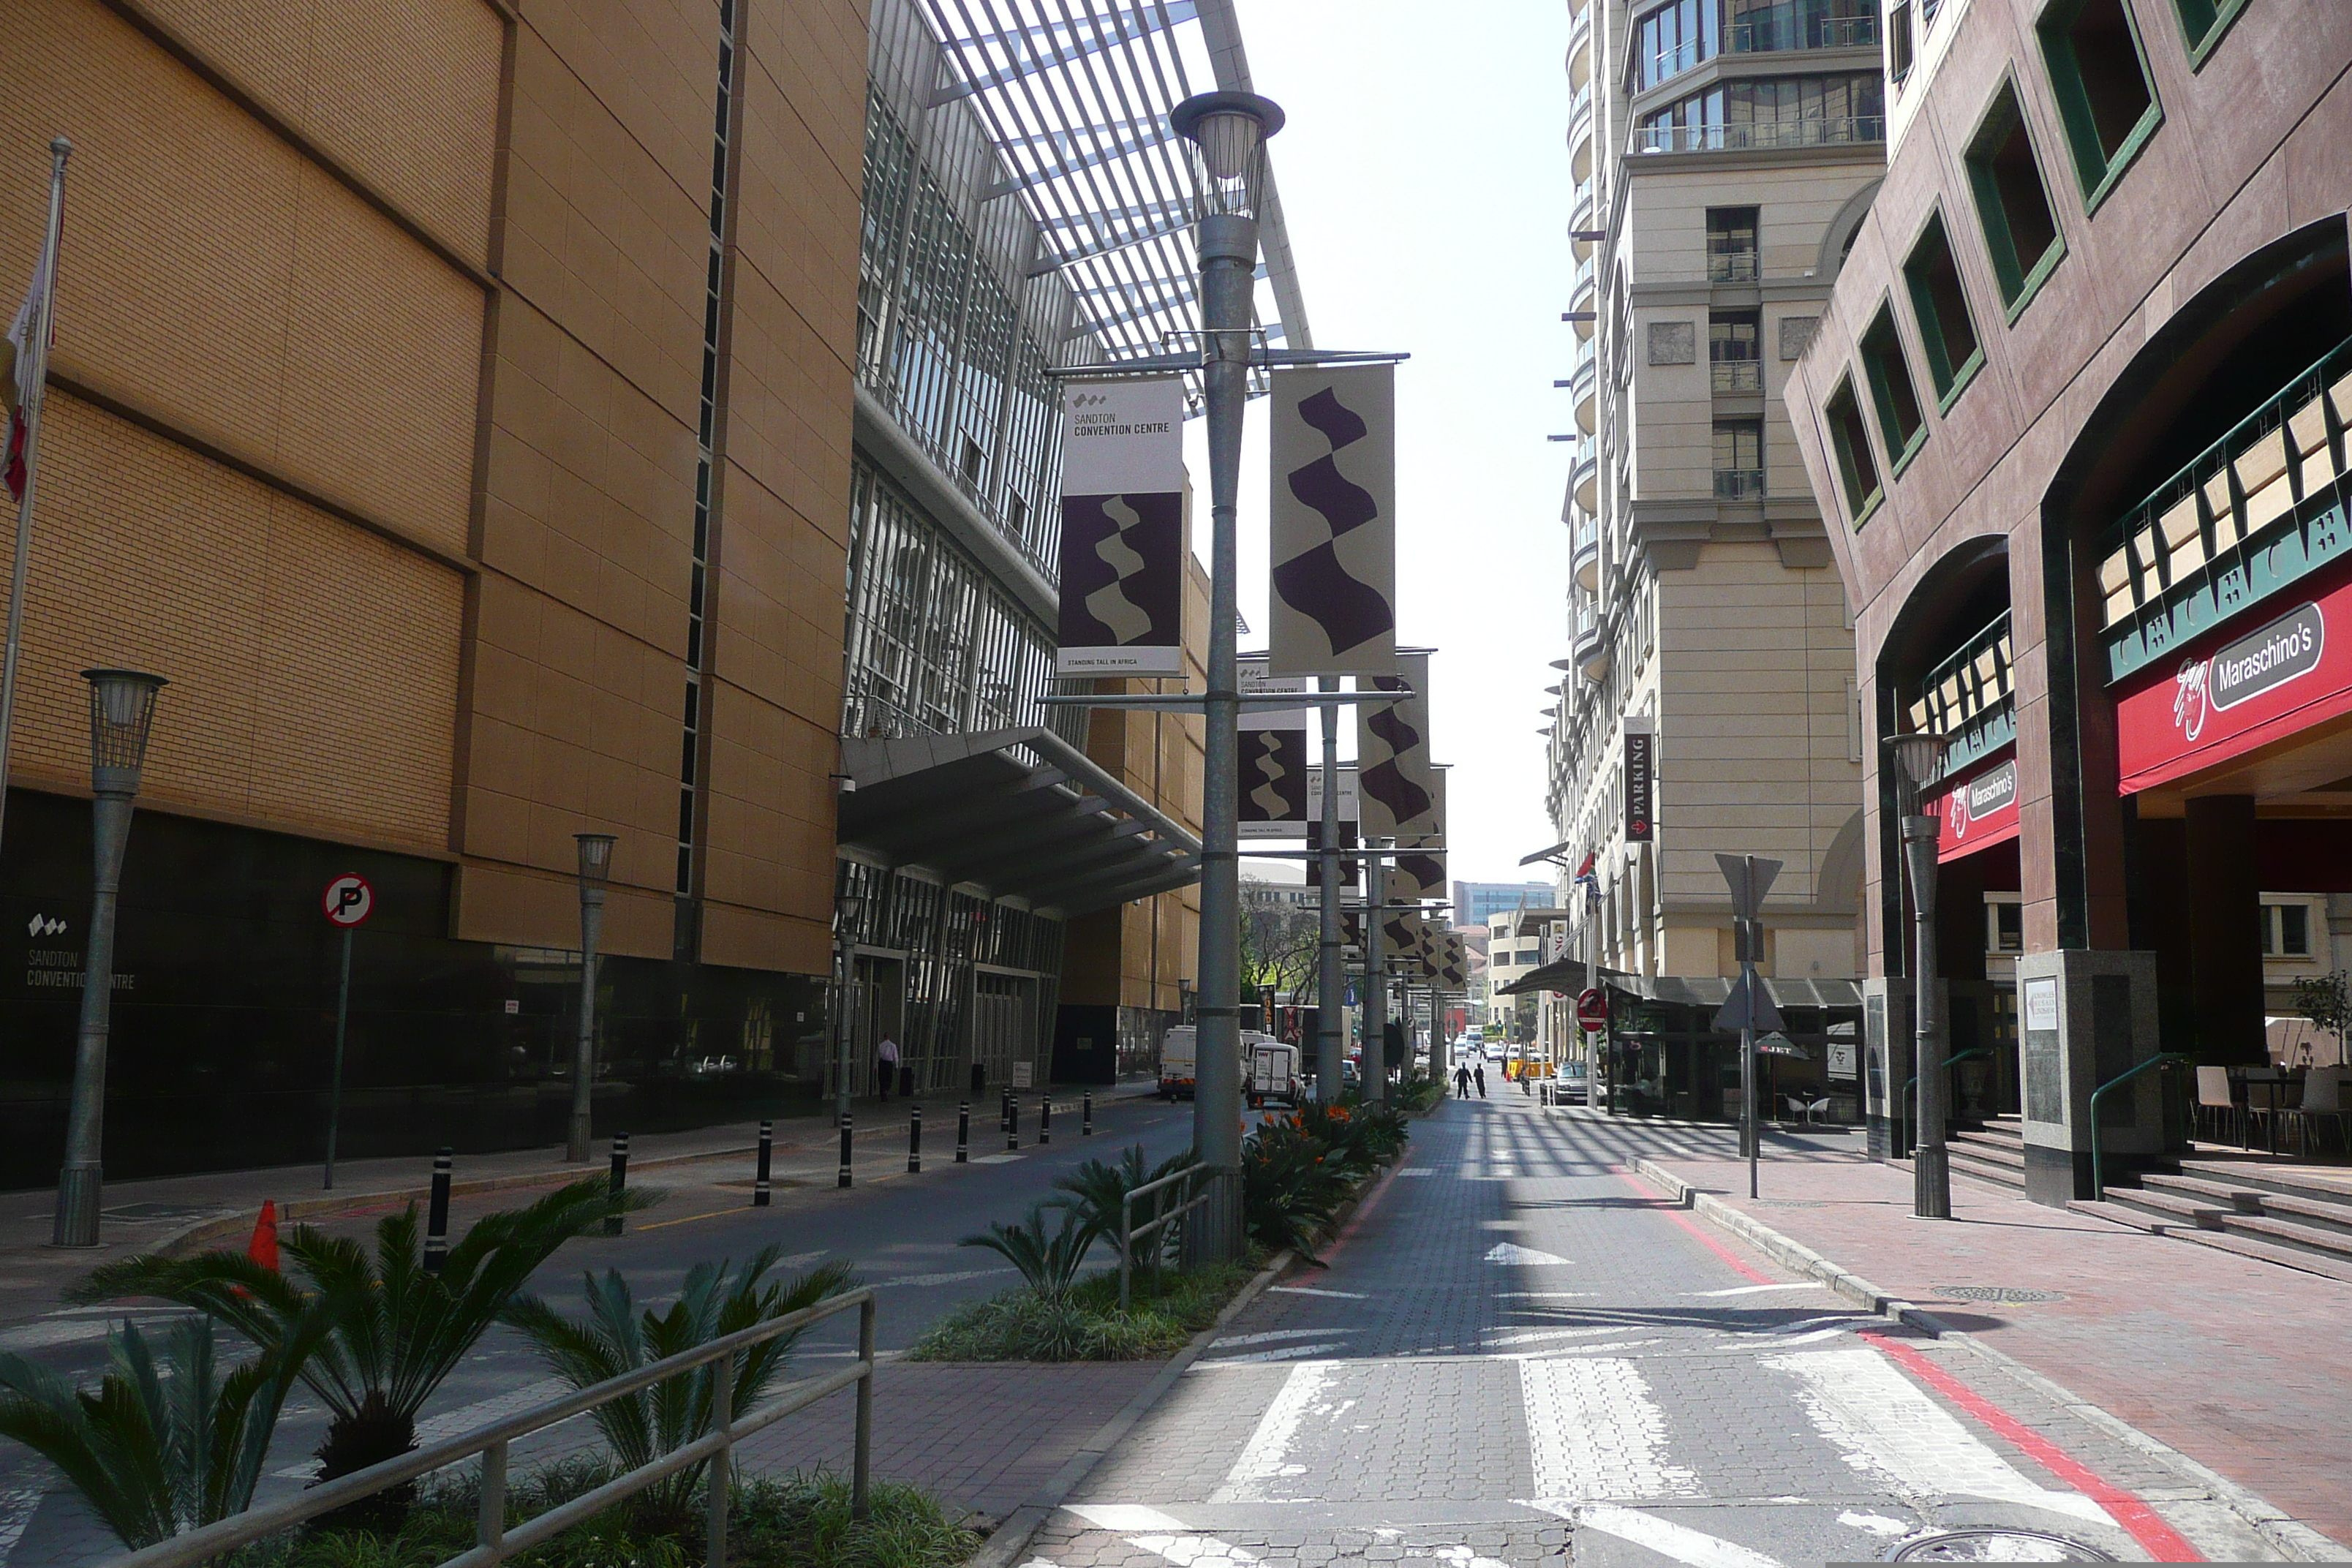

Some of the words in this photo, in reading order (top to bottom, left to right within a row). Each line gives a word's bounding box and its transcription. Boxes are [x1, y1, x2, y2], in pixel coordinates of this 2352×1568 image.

[1074, 413, 1116, 424] SANDTON
[1074, 424, 1131, 437] CONVENTION
[1134, 422, 1169, 434] CENTRE
[2218, 622, 2312, 692] Maraschino's
[1632, 739, 1645, 815] PARKING
[1971, 771, 2013, 809] Maraschino's
[339, 887, 362, 916] P
[28, 950, 78, 968] SANDTON
[27, 970, 86, 987] CONVENTIO
[111, 974, 135, 990] NTRE
[1768, 1046, 1792, 1055] JET
